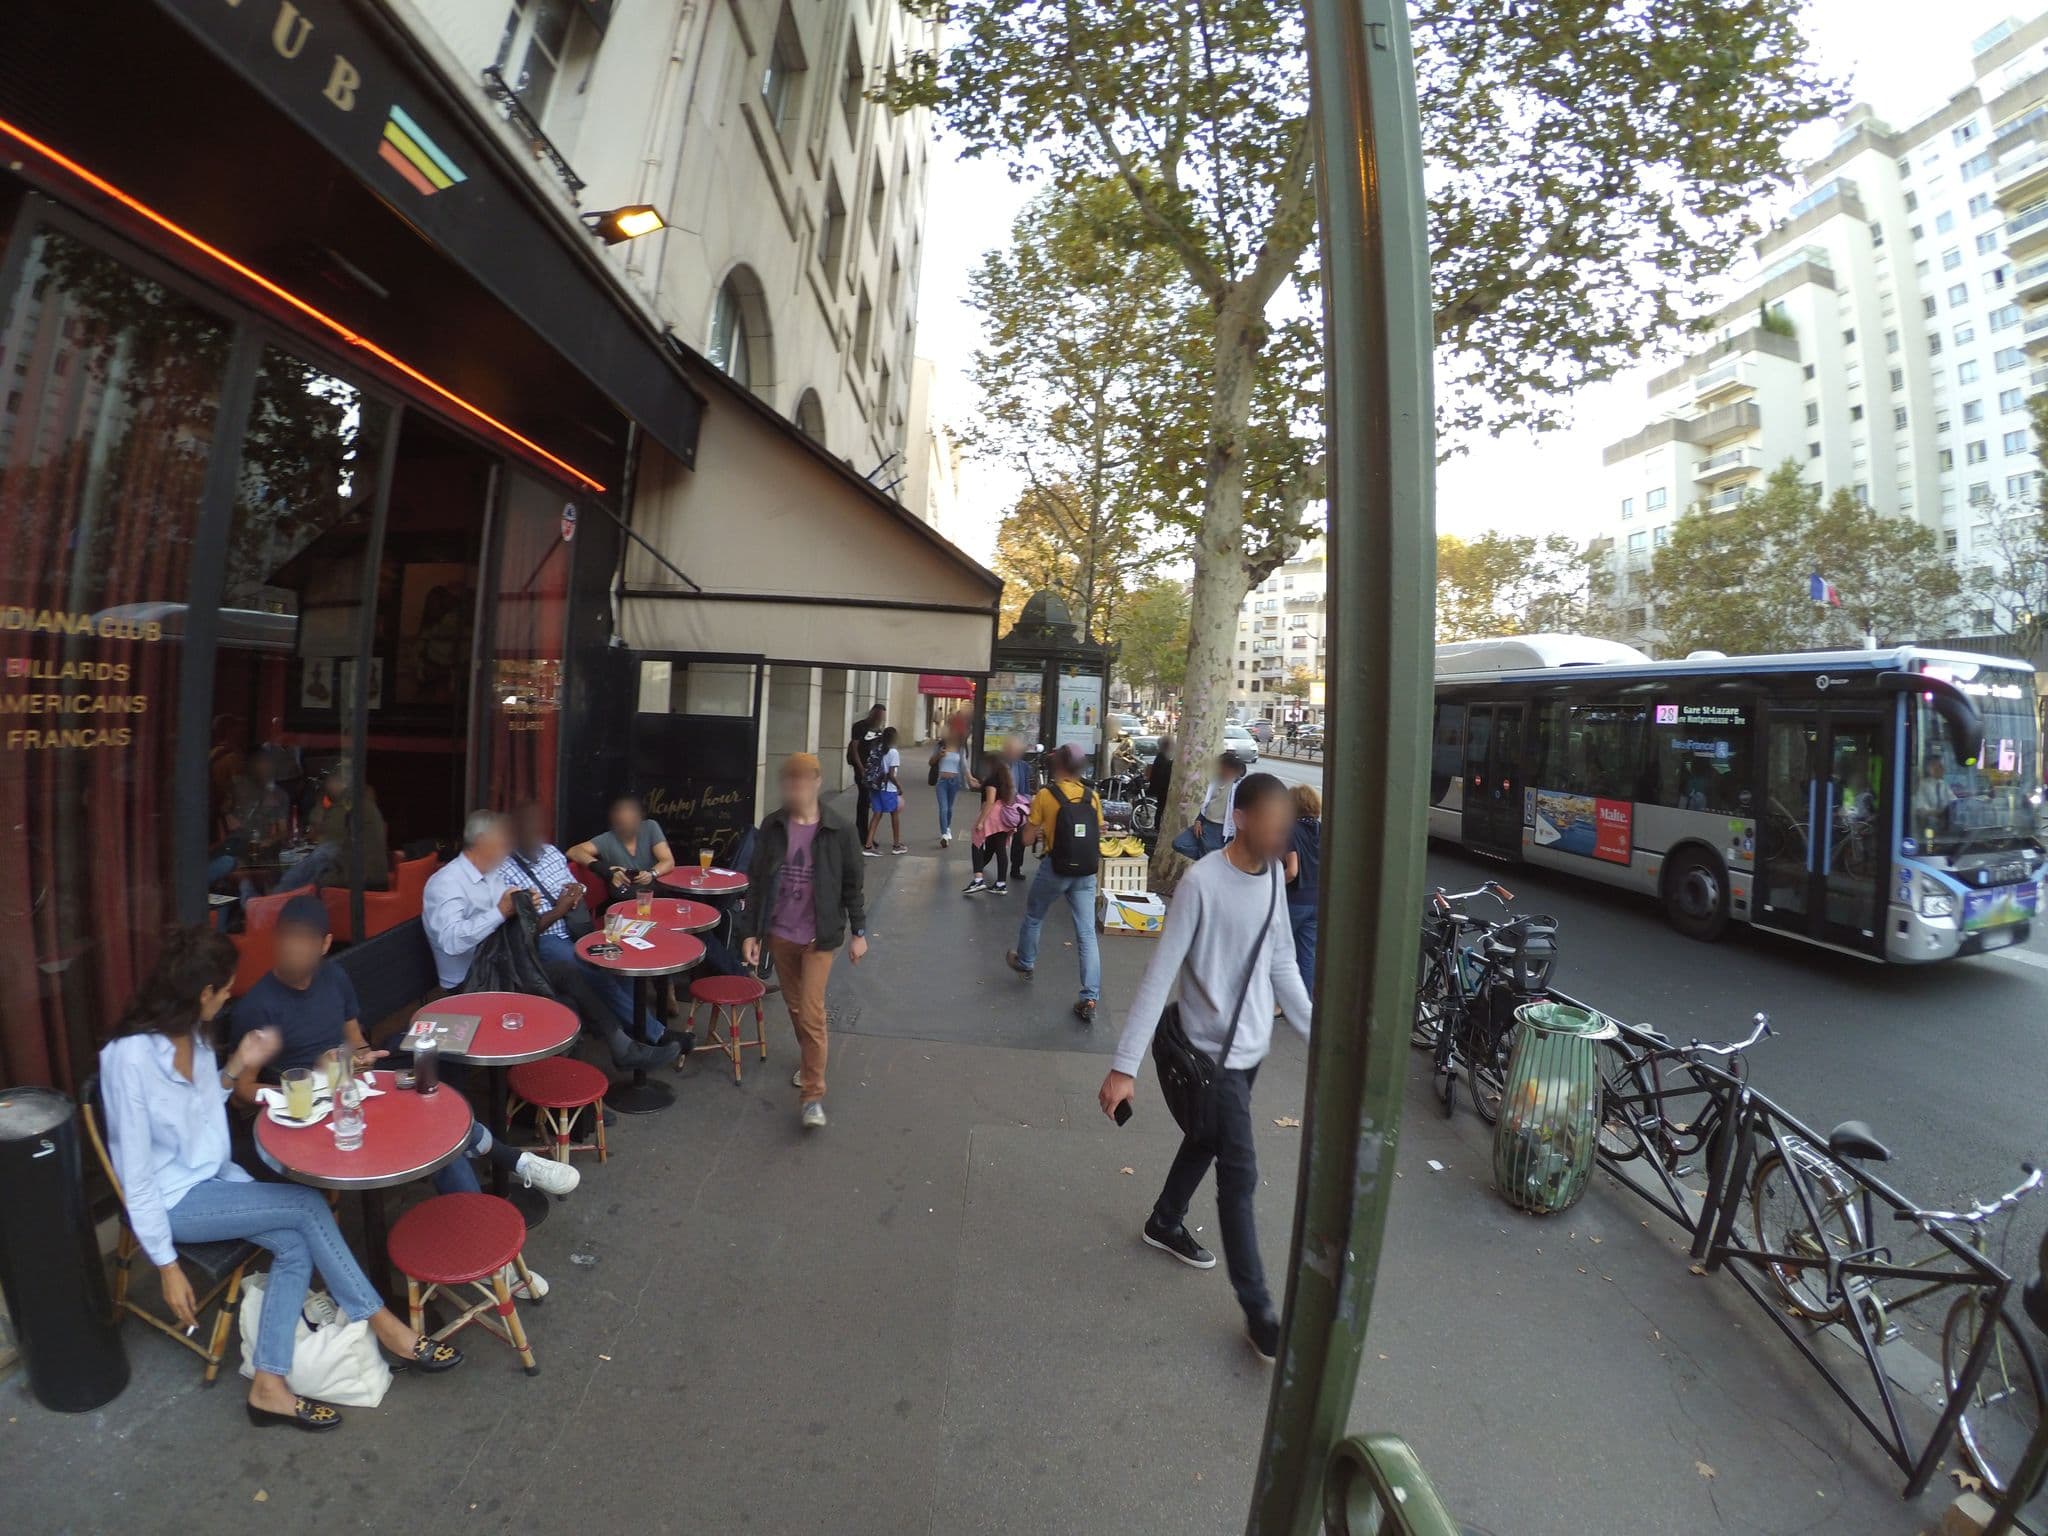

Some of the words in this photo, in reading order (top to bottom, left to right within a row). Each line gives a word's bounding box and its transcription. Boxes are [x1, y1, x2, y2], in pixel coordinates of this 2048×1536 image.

[226, 0, 362, 112] UB
[98, 616, 162, 642] CLUB
[6, 657, 131, 682] BILLARDS
[1661, 706, 1675, 722] 28
[1683, 705, 1701, 715] Gare
[1702, 705, 1740, 716] St-Lazare
[648, 785, 697, 818] Happy
[700, 785, 742, 809] hour
